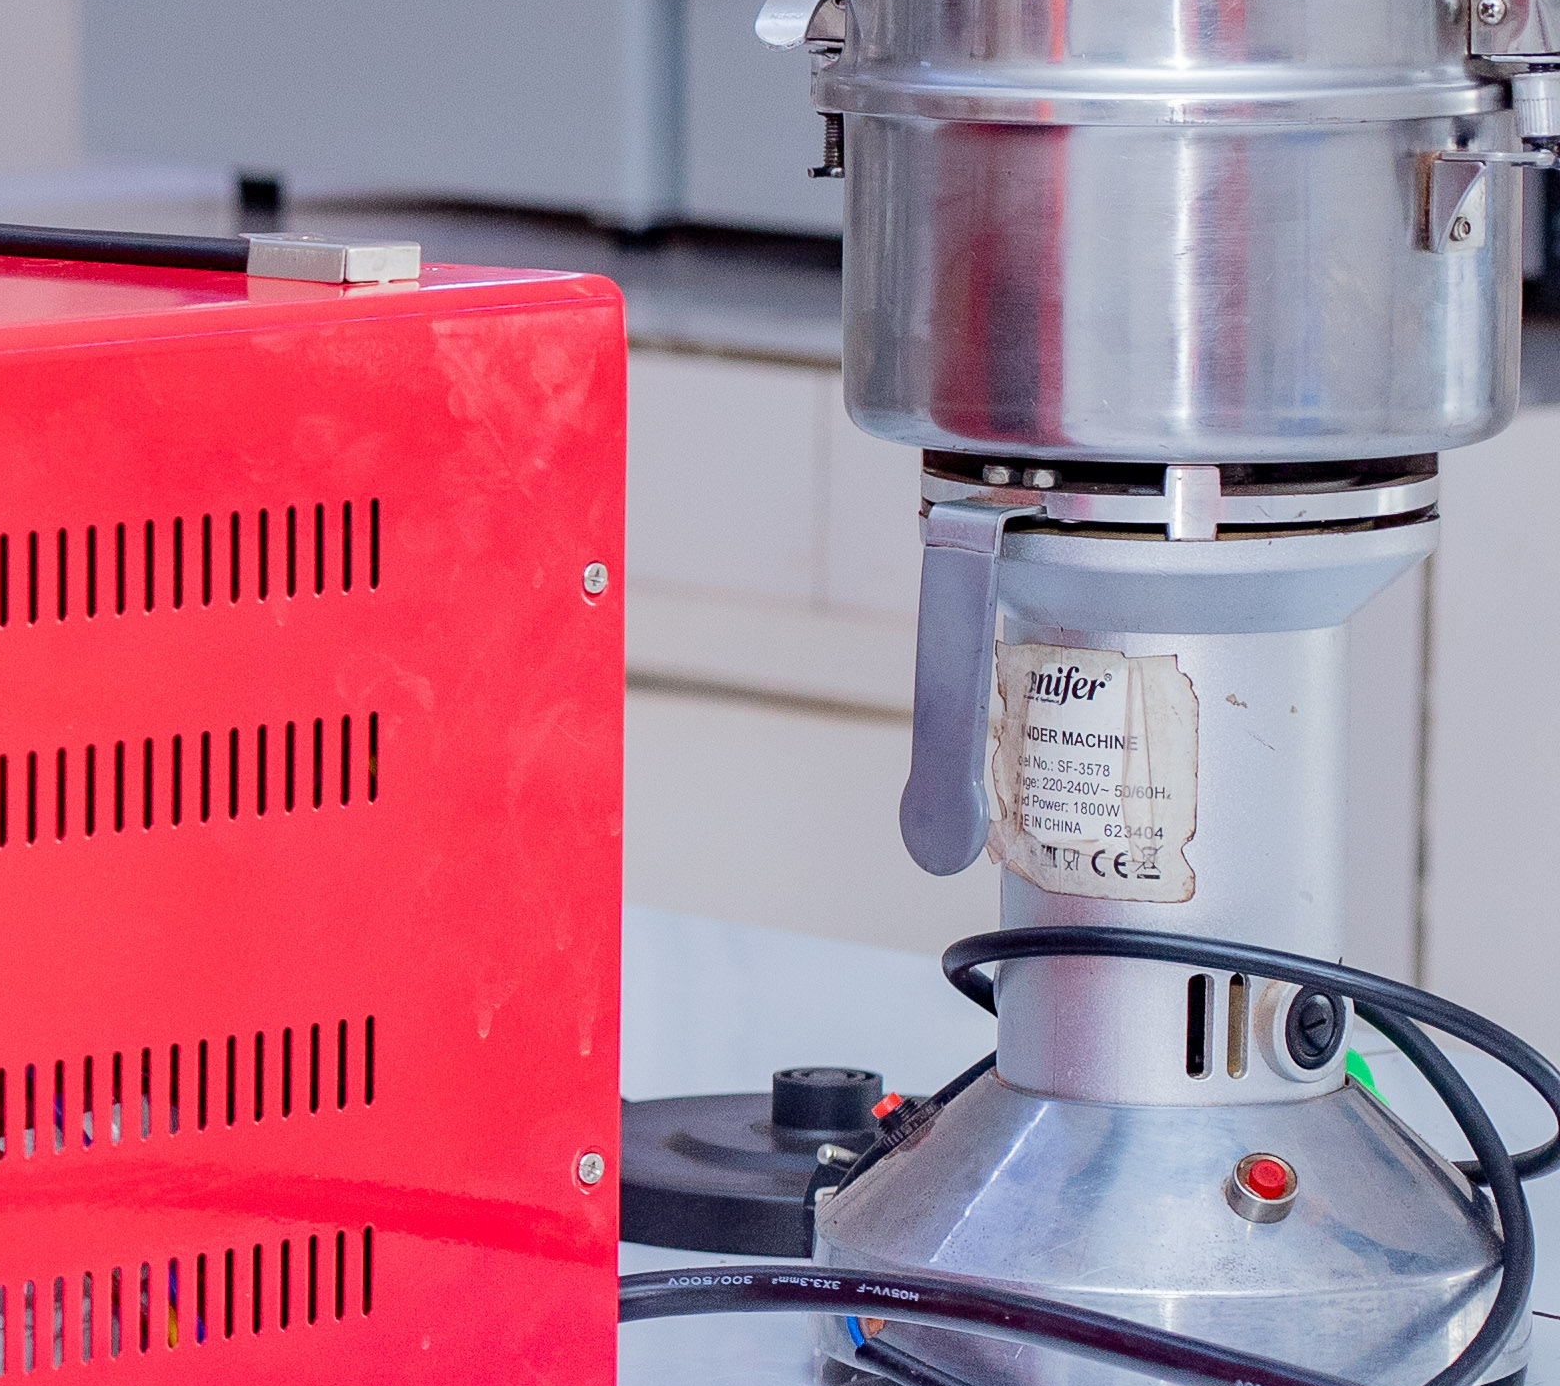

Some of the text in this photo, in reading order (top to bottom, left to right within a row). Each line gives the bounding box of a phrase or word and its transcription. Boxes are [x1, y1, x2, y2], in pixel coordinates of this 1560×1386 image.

[1062, 730, 1140, 752] MACHINE
[1033, 755, 1054, 771] No.:
[1058, 759, 1111, 778] SF-3578
[1033, 794, 1069, 813] Power:
[1073, 801, 1121, 818] 1800W
[1031, 815, 1042, 829] IN
[1045, 817, 1082, 835] CHINA
[1104, 823, 1165, 841] 623404
[668, 1275, 754, 1286] 300/500V
[856, 1283, 920, 1302] H05VV-F
